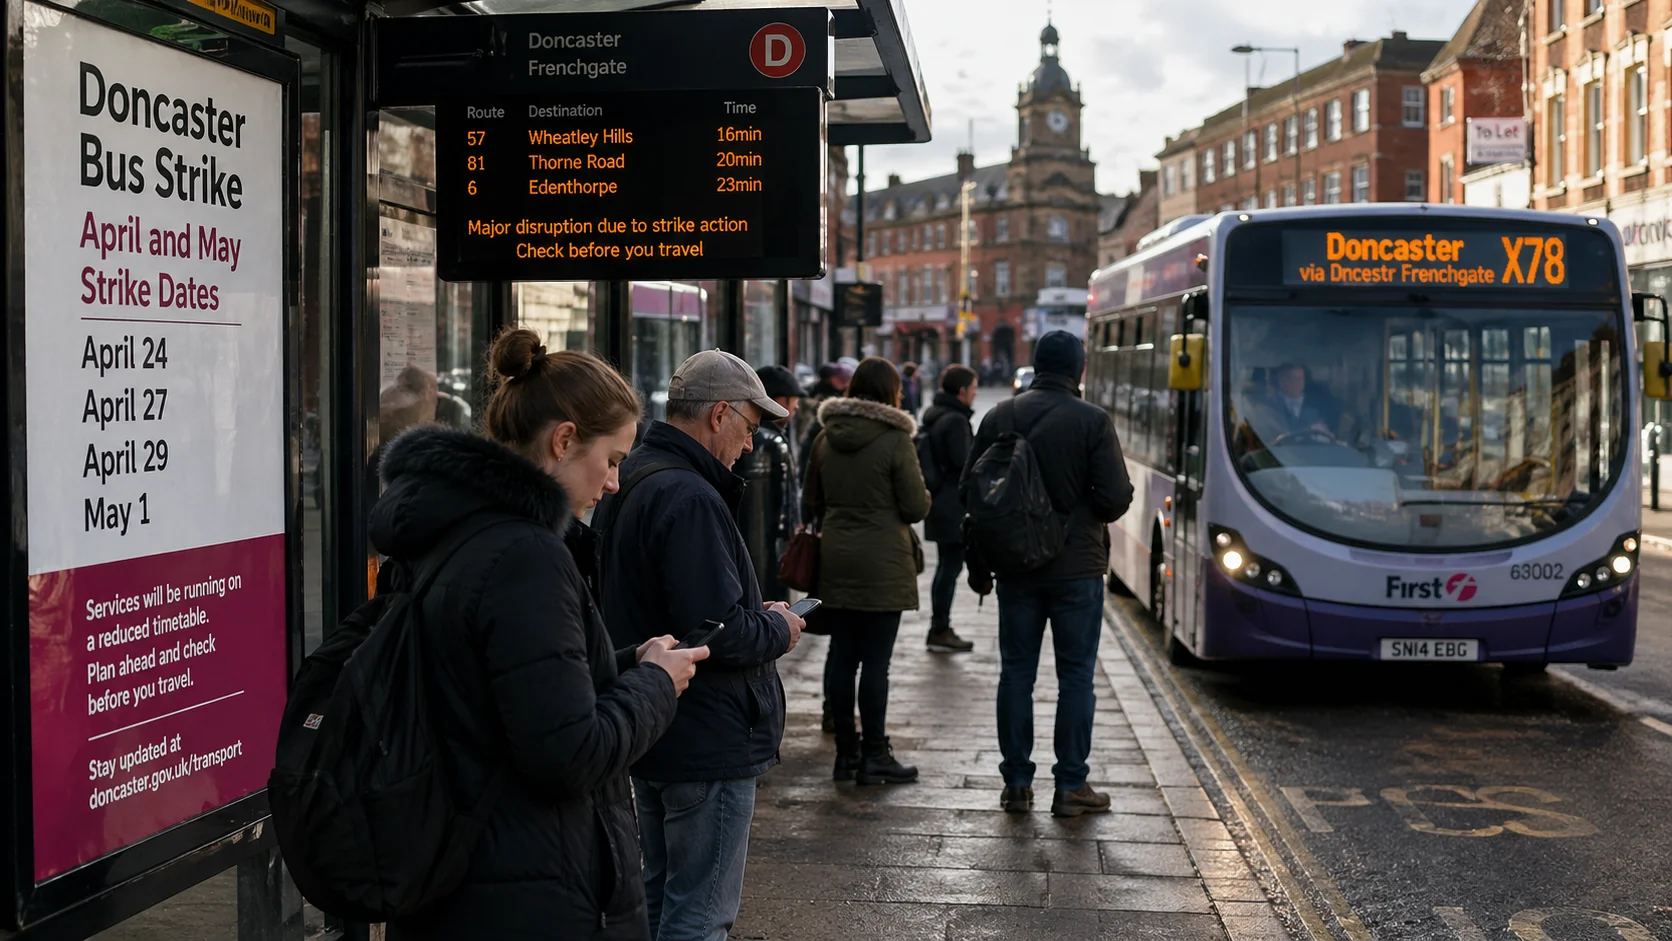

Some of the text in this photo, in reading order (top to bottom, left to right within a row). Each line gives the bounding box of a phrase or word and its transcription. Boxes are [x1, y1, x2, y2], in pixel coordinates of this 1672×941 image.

[528, 32, 621, 50] Doncaster
[764, 34, 792, 67] D
[528, 59, 627, 79] Frenchgate
[80, 61, 246, 148] Doncaster
[467, 101, 757, 119] Route Destination Time
[467, 126, 762, 148] 57 Wheatley Hills 16min
[80, 132, 243, 209] Bus Strike
[467, 152, 762, 171] 81 Thorne Road 20min
[467, 177, 762, 197] 6 Edenthorpe 23min
[80, 211, 241, 272] April and May
[468, 218, 748, 238] Major disruption due to strike action
[1326, 232, 1464, 262] Doncaster
[516, 241, 703, 260] Check before you travel
[1501, 236, 1565, 285] X78
[81, 266, 219, 310] Strike Dates
[1299, 264, 1495, 287] via Dncestr Frenchgate
[81, 335, 168, 377] April 24
[82, 388, 168, 430] April 27
[83, 439, 168, 484] April 29
[84, 493, 150, 536] May 1
[1386, 575, 1443, 599] First
[1510, 563, 1564, 580] 63002
[86, 574, 242, 621] Services will be running on
[87, 606, 209, 652] a reduced timetable.
[1392, 642, 1467, 657] SN14 EBG
[88, 633, 216, 684] Plan ahead and check
[88, 668, 194, 715] before you travel.
[89, 733, 182, 781] Stay updated at
[89, 740, 243, 810] doncaster.gov.uk/transport
